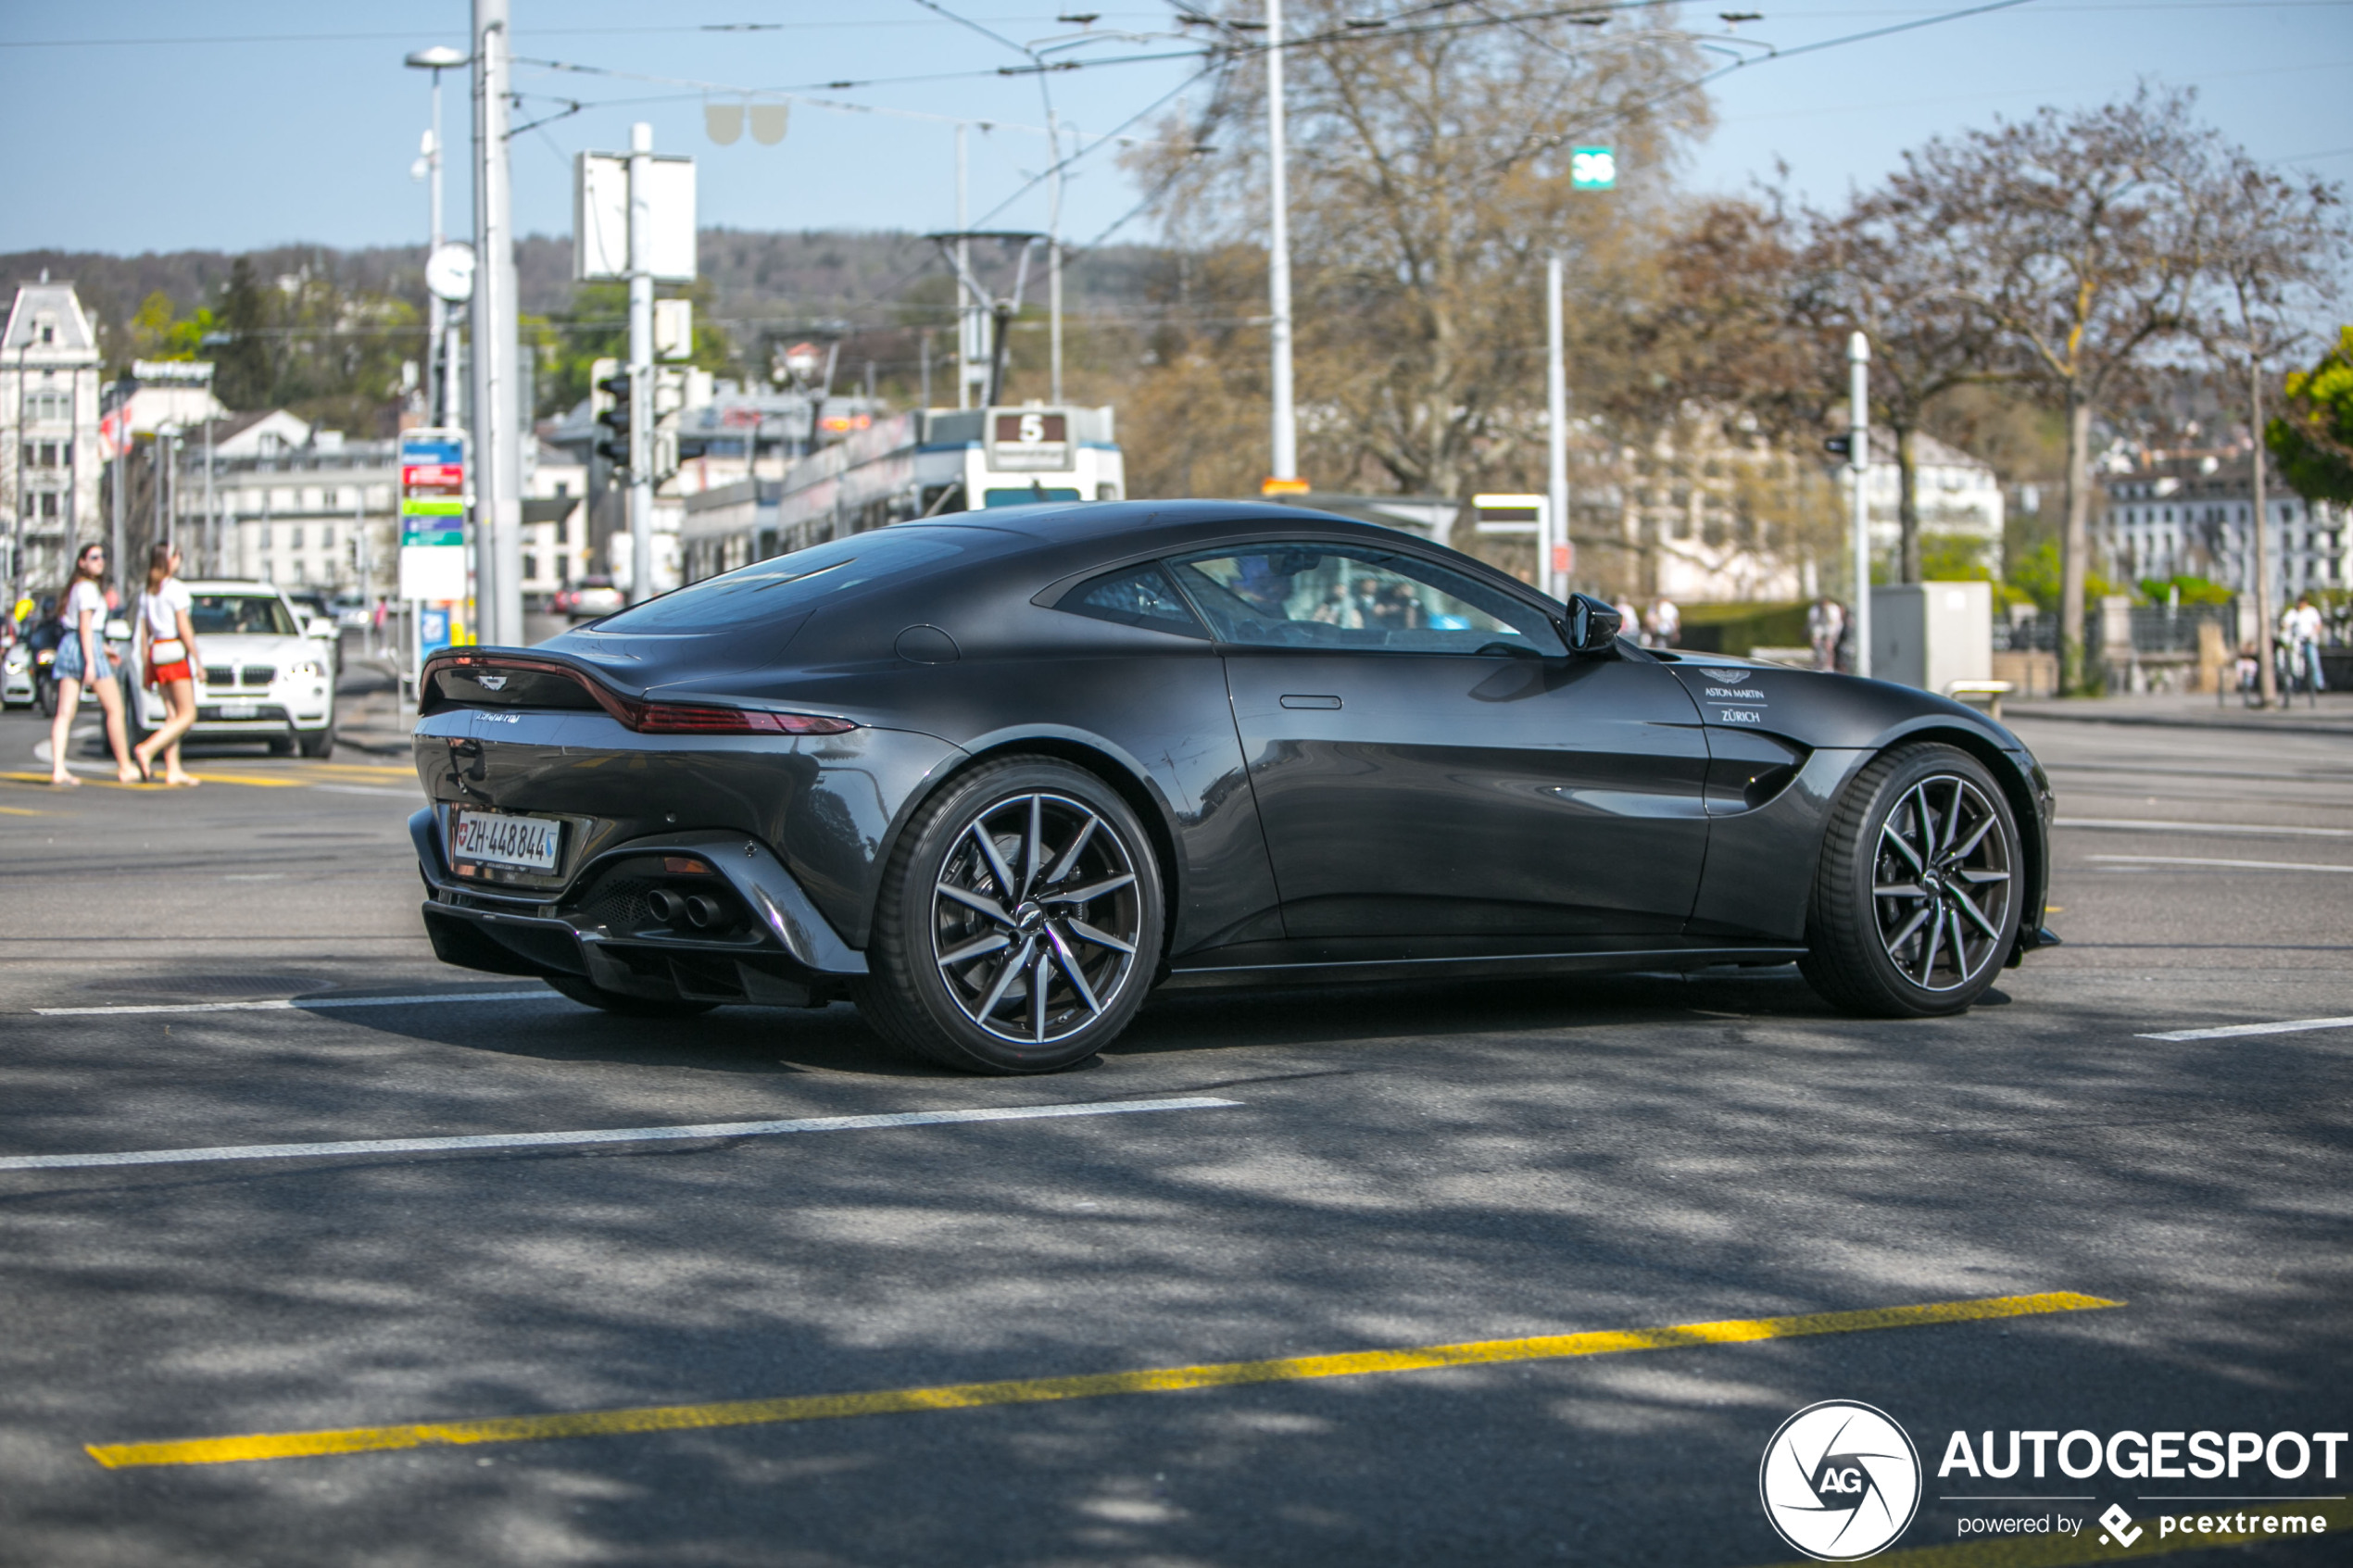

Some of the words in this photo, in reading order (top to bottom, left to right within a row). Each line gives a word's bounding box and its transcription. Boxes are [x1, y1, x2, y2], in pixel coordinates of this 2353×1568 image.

[1020, 413, 1044, 443] 5
[1705, 687, 1732, 697] ASTON
[1732, 689, 1765, 698] MARTIN
[1721, 709, 1761, 722] ZÜRICH
